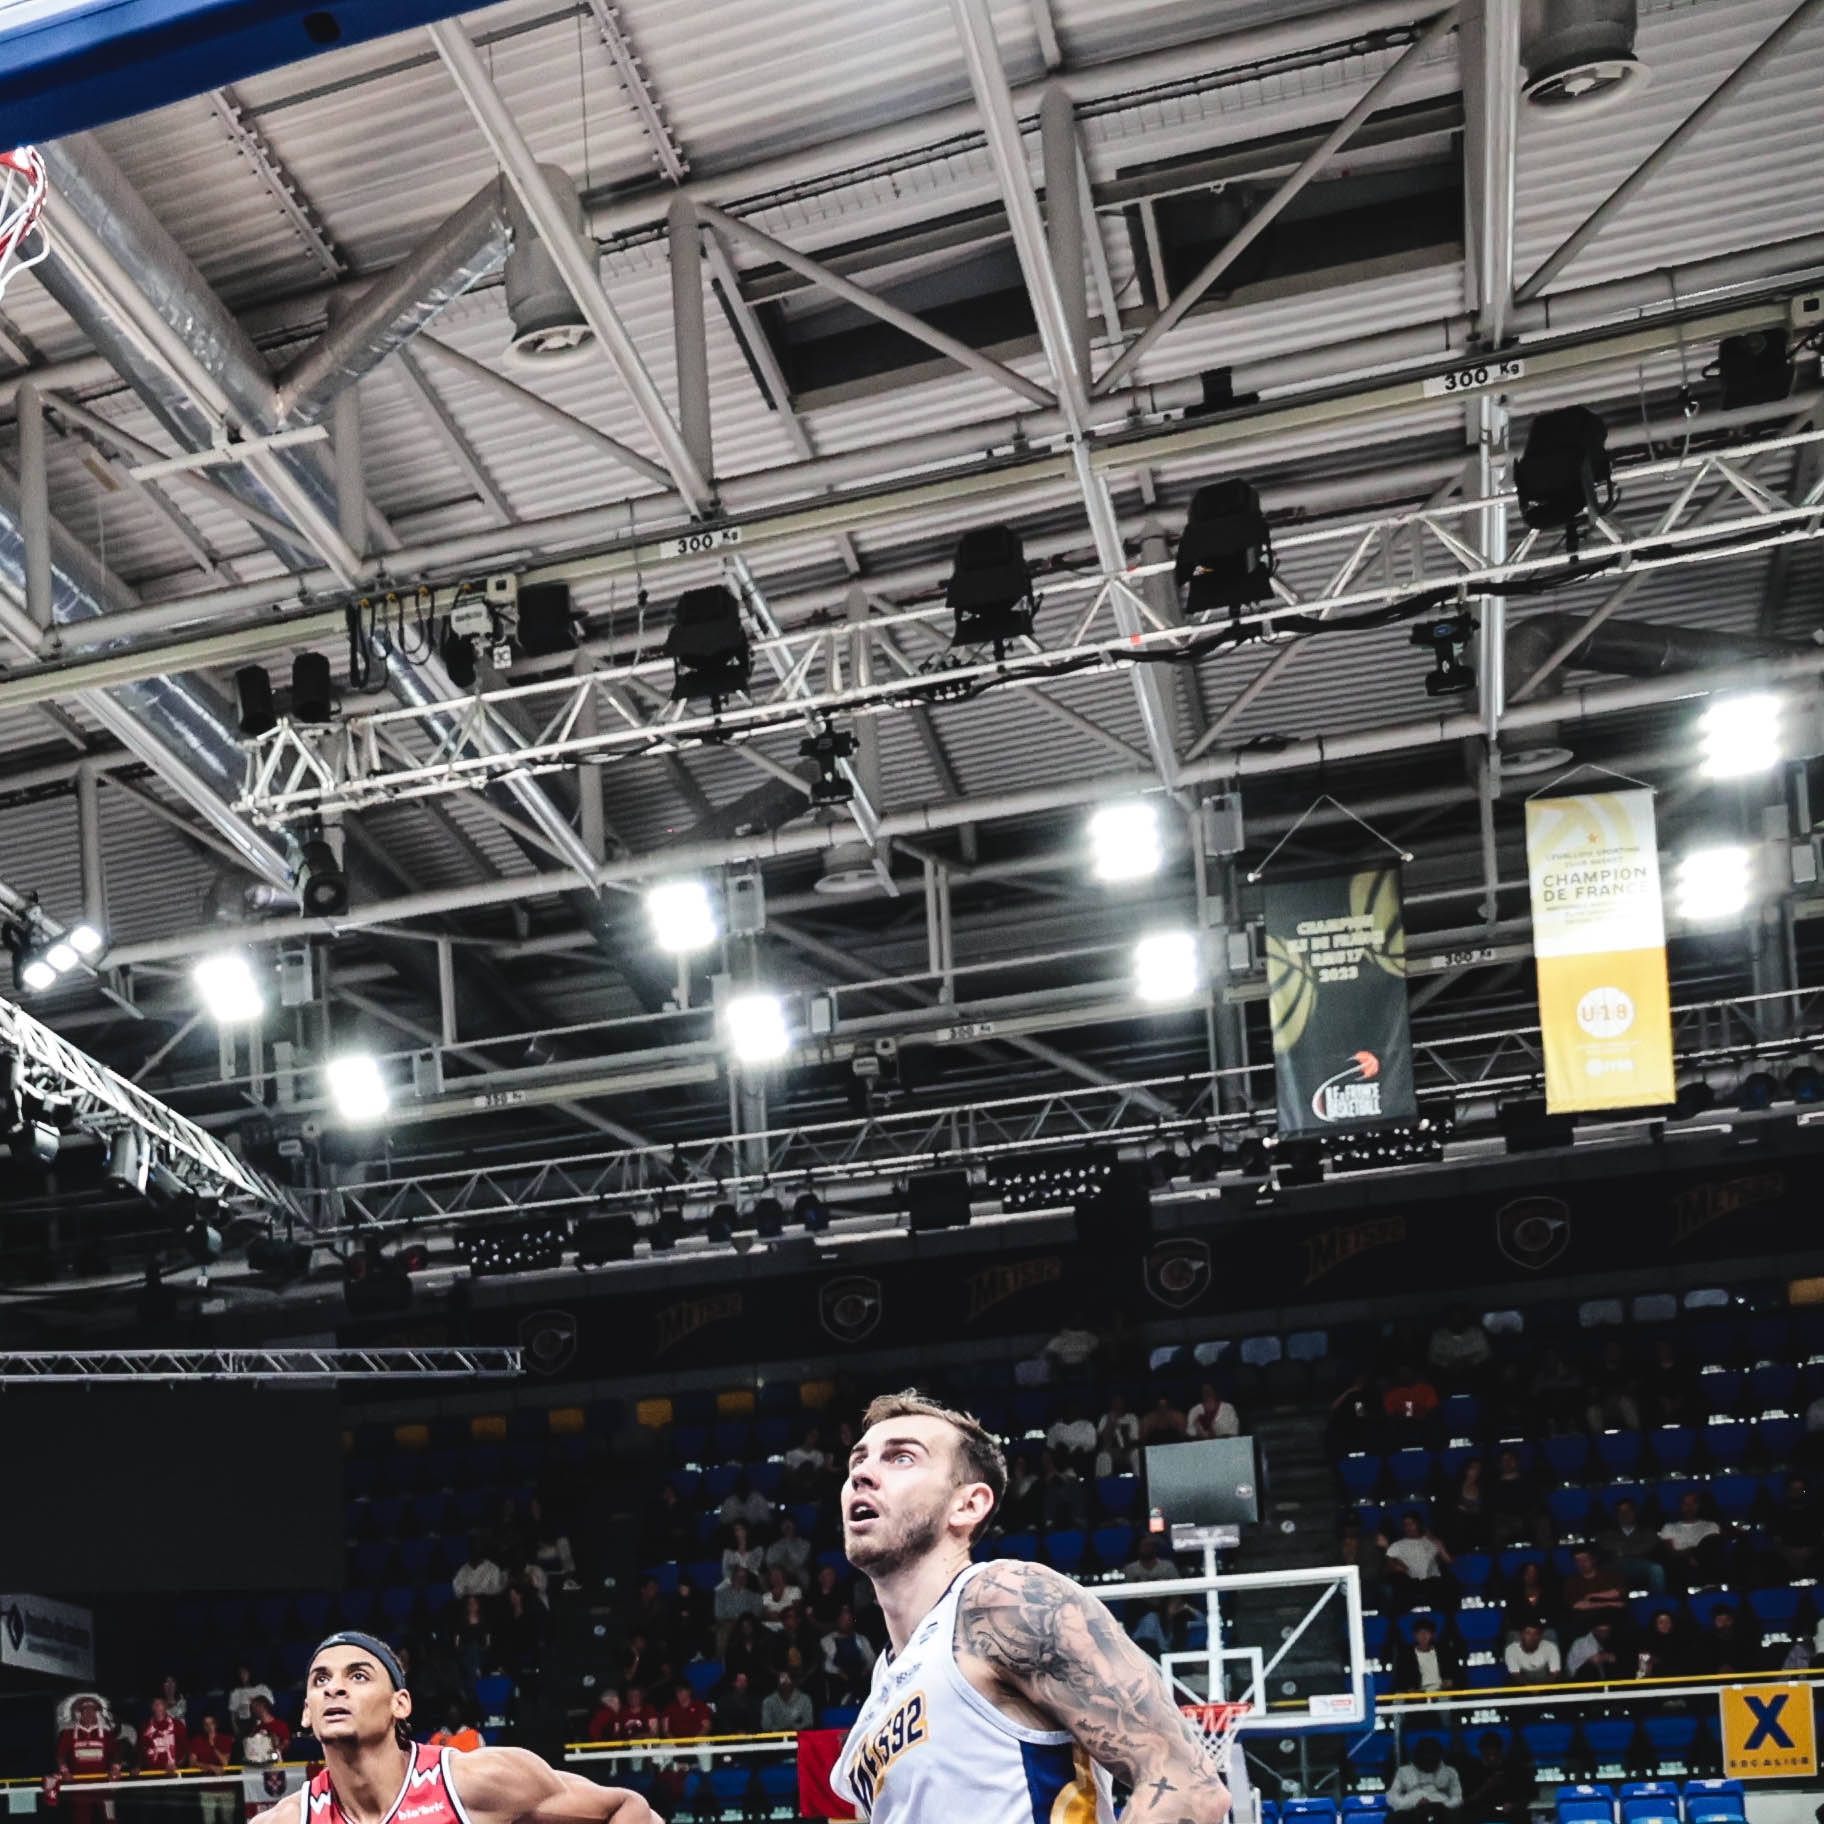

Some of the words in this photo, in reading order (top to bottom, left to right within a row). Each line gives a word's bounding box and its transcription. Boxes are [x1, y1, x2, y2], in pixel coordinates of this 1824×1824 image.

[1542, 867, 1647, 888] CHAMPION
[1543, 887, 1568, 902] DE
[1743, 1694, 1796, 1750] X
